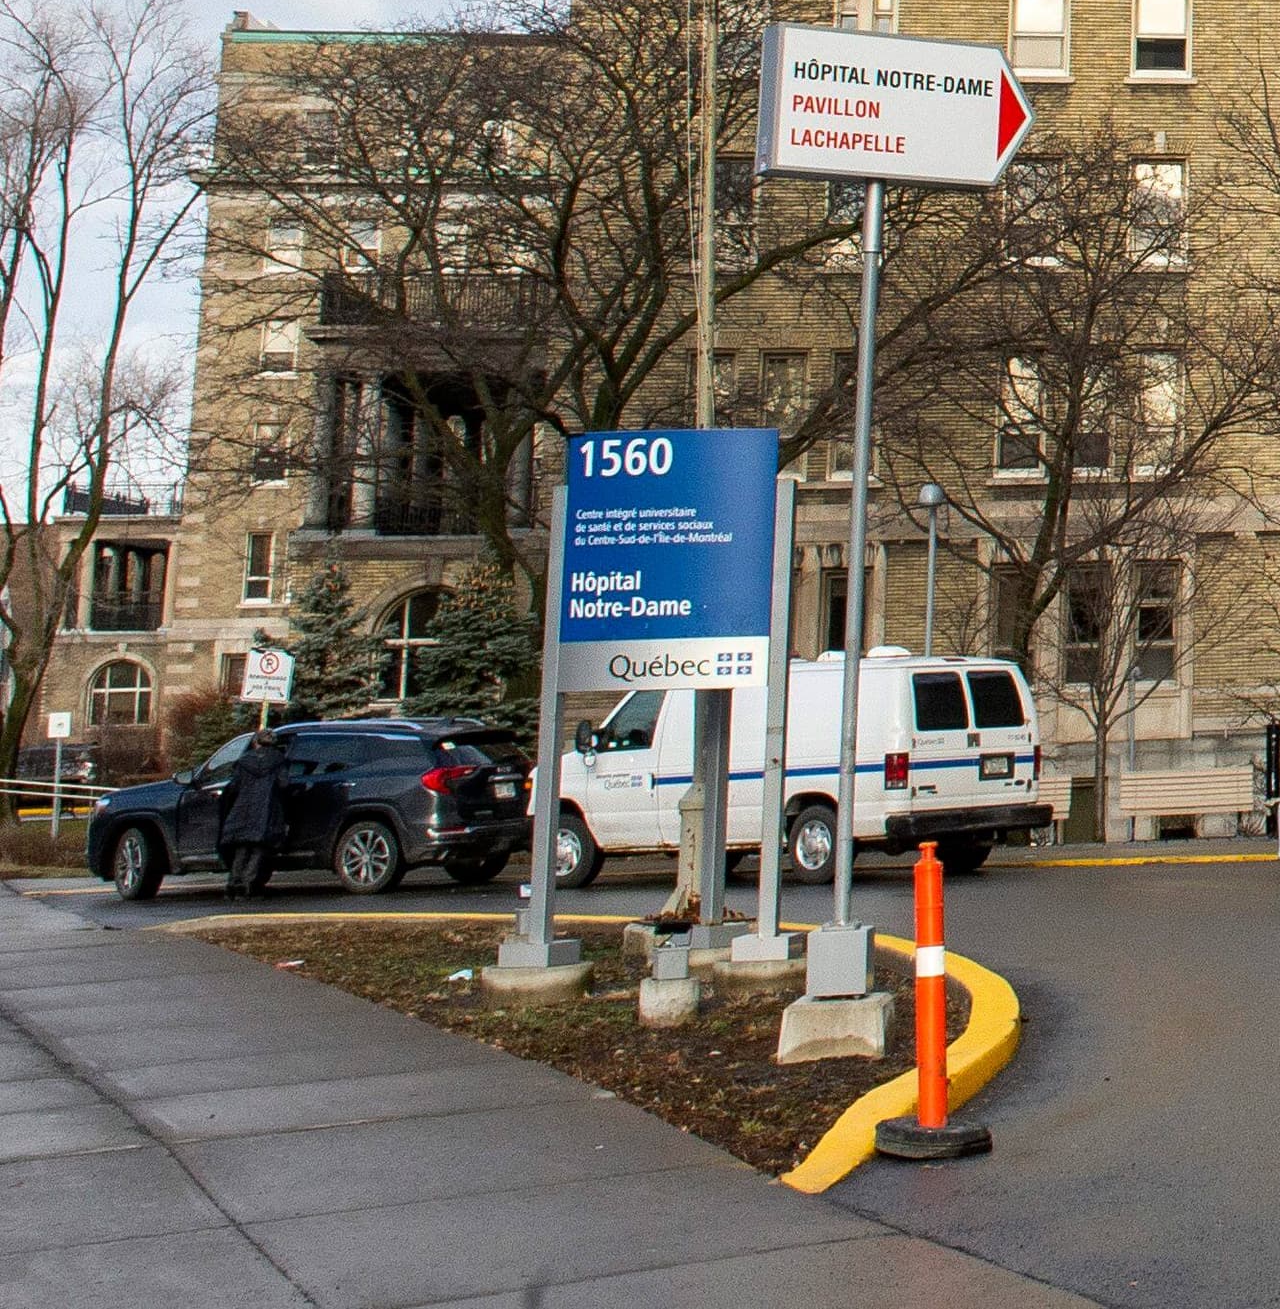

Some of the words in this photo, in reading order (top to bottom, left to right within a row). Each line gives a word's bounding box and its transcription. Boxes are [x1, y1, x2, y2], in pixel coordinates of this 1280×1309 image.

[794, 59, 870, 86] HÔPITAL
[877, 69, 994, 97] NOTRE-DAME
[792, 95, 880, 118] PAVILLON
[791, 128, 905, 154] LACHAPELLE
[580, 437, 673, 477] 1560
[576, 509, 603, 520] Centre
[605, 508, 637, 520] intégré
[639, 507, 696, 518] universitaire
[575, 522, 587, 533] de
[588, 521, 611, 532] santé
[613, 522, 623, 531] et
[624, 521, 637, 531] de
[638, 520, 676, 531] services
[678, 520, 714, 530] sociaux
[575, 535, 586, 546] du
[571, 570, 641, 595] Hôpital
[570, 596, 691, 619] Notre-Dame
[609, 652, 710, 682] Québec
